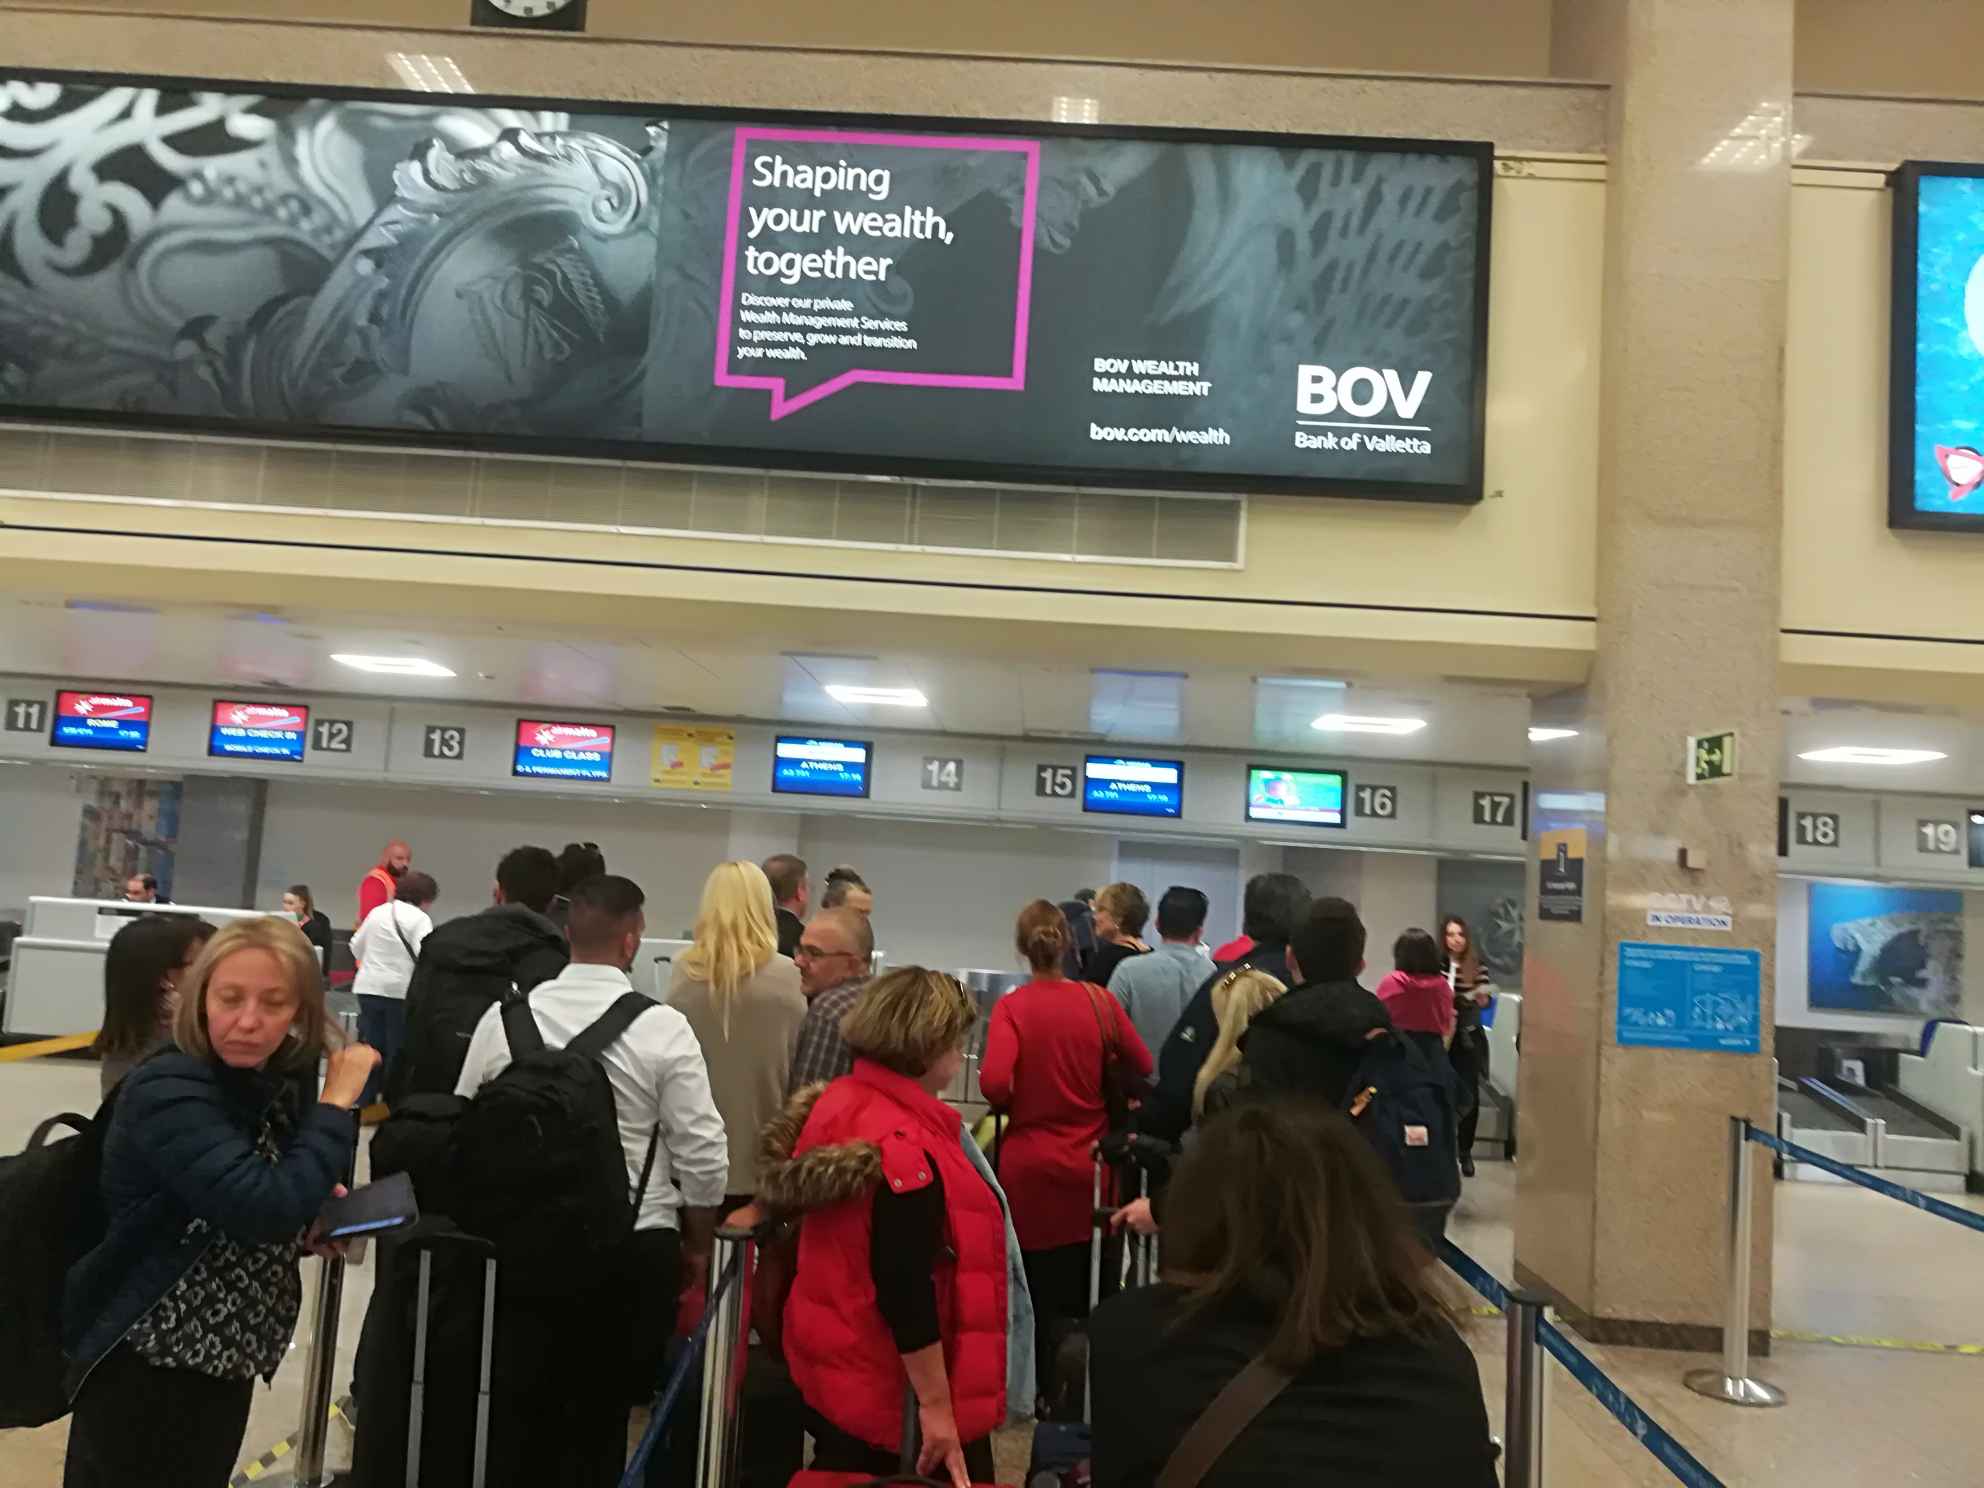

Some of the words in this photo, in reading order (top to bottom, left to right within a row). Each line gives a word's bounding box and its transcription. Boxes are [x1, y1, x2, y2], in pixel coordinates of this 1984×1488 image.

[752, 155, 890, 200] Shaping
[747, 206, 826, 238] your
[834, 206, 954, 244] wealth,
[745, 246, 893, 284] together
[741, 293, 789, 307] Discover
[791, 298, 812, 308] our
[813, 297, 854, 311] private
[739, 310, 780, 325] Wealth
[781, 312, 859, 329] Management
[860, 316, 909, 332] Services
[738, 328, 752, 340] to
[753, 330, 805, 344] preserve,
[805, 332, 837, 346] grow
[838, 333, 862, 346] and
[863, 334, 918, 350] transition
[737, 346, 764, 359] your
[765, 347, 808, 361] wealth.
[1094, 358, 1129, 374] BOV
[1131, 359, 1199, 376] WEALTH
[1093, 377, 1212, 396] MANAGEMENT
[1296, 364, 1433, 419] BOV
[1090, 422, 1231, 446] bov.com/wealth
[1295, 431, 1339, 450] Bank
[1341, 432, 1361, 450] of
[1363, 434, 1432, 455] Valletta
[13, 703, 40, 730] 11
[317, 721, 348, 749] 12
[429, 729, 461, 757] 13
[531, 747, 563, 760] CLUB
[563, 750, 601, 762] CLASS
[926, 759, 959, 789] 14
[1040, 767, 1073, 796] 15
[1358, 787, 1393, 816] 16
[1478, 795, 1510, 823] 17
[1800, 815, 1835, 844] 18
[1920, 823, 1957, 851] 19
